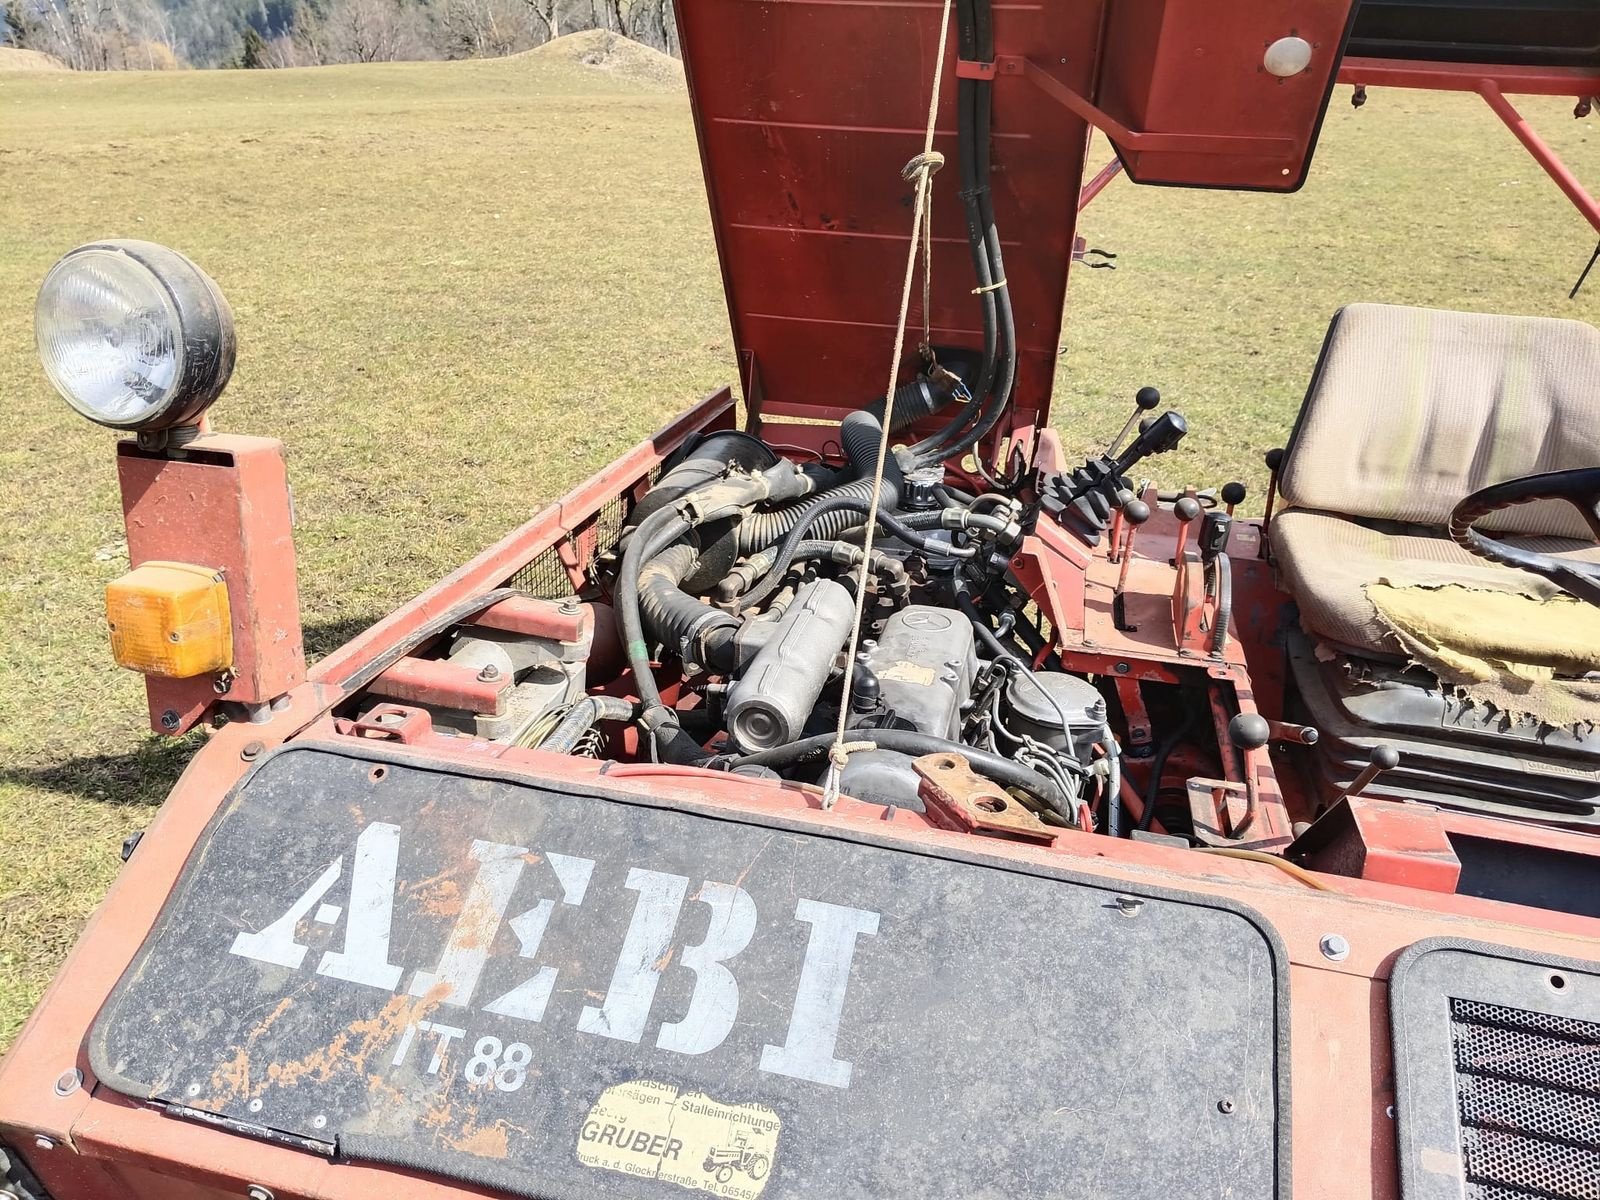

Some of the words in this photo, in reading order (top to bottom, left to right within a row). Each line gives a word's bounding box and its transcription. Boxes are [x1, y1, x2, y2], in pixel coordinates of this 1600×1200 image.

[228, 821, 881, 1088] AEBI
[464, 1035, 533, 1092] 88
[581, 1121, 683, 1161] GRUBER
[704, 1180, 718, 1192] Tel.
